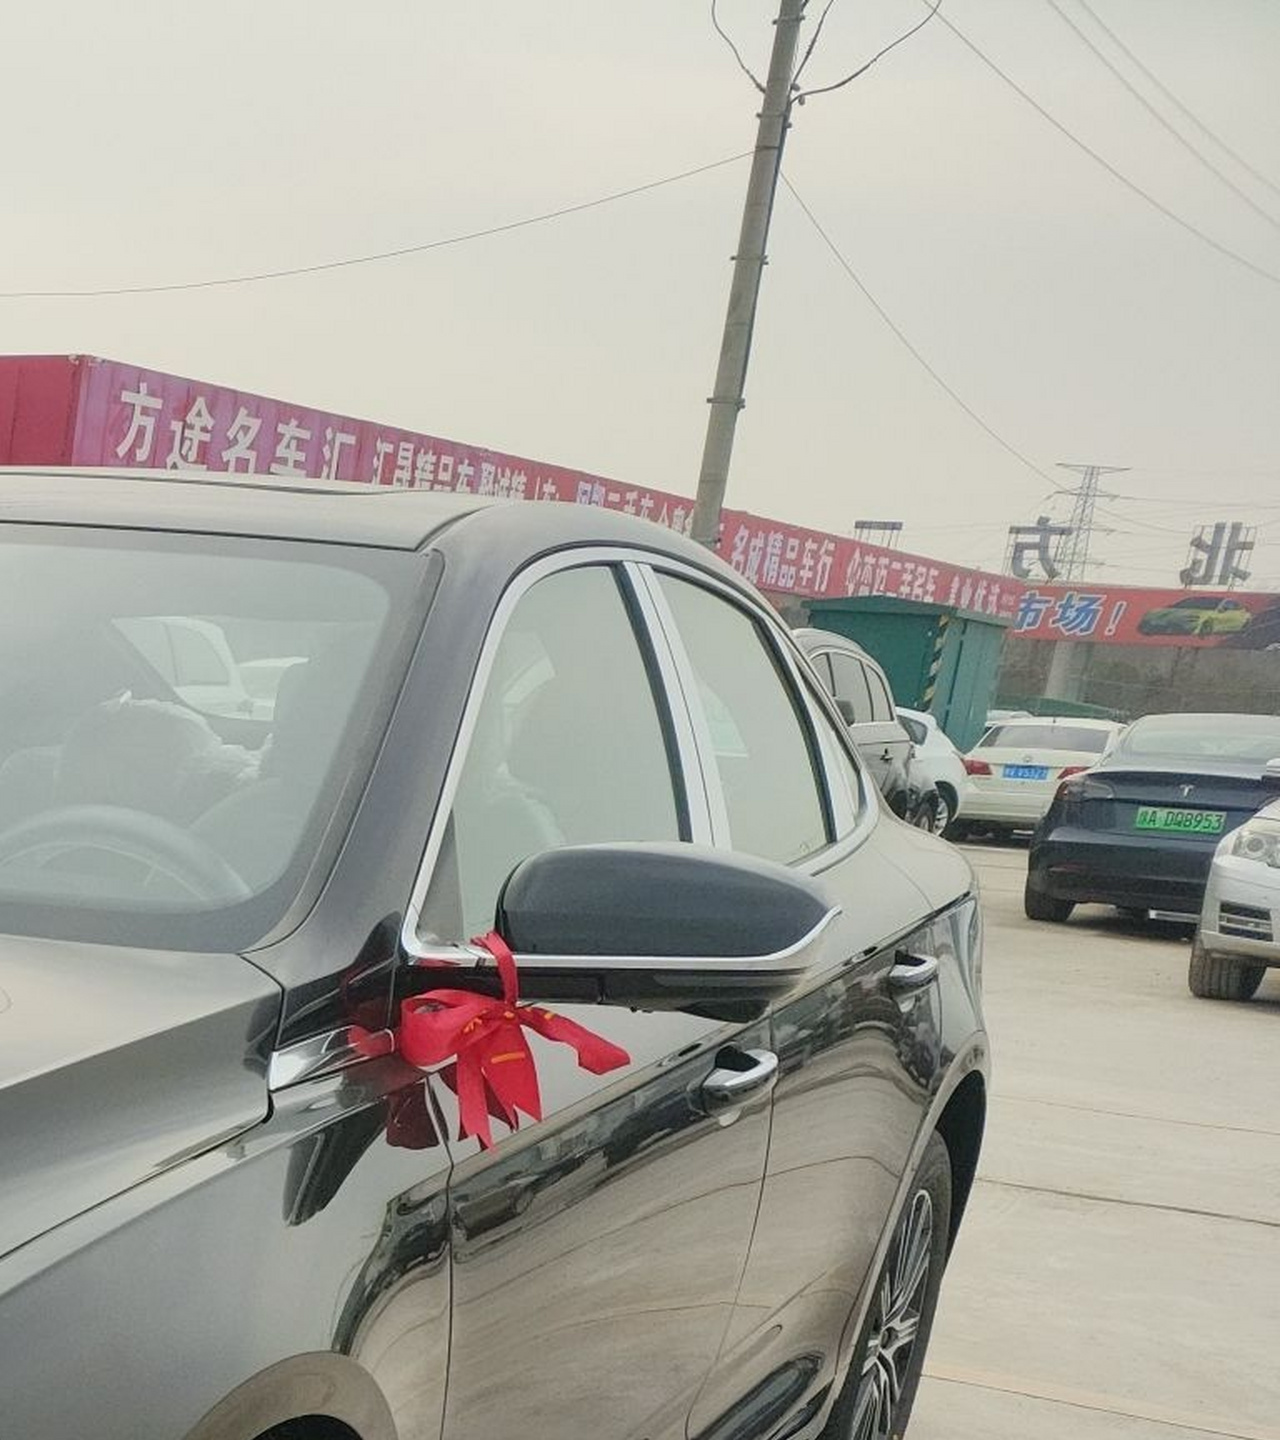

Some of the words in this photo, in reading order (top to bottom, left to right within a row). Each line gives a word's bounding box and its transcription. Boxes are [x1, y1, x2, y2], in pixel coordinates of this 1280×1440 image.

[116, 382, 357, 480] 方途名车汇
